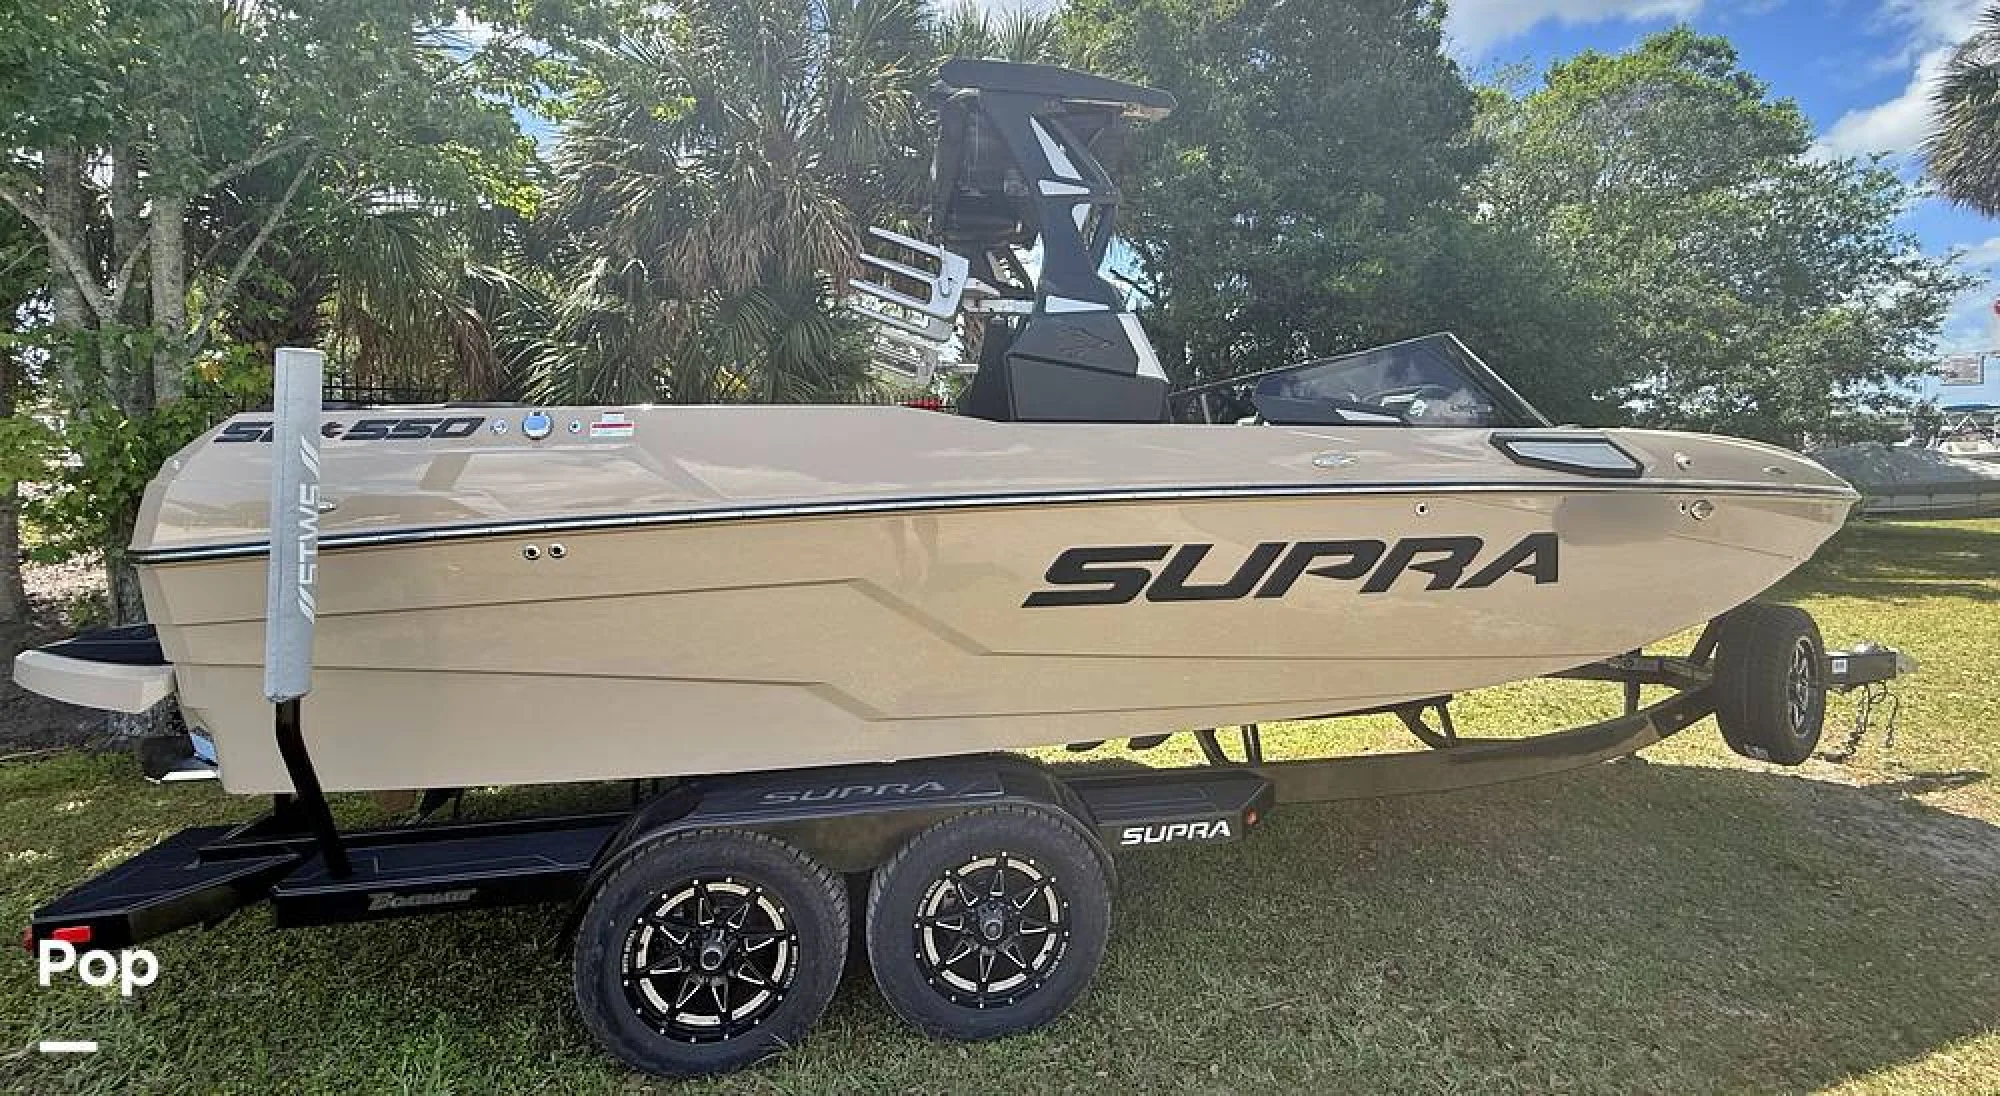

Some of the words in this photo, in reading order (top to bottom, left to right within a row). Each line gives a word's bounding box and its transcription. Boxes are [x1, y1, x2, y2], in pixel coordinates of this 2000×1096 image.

[342, 417, 486, 440] 550
[1021, 531, 1559, 608] SUPRA
[758, 781, 945, 804] SUPRA
[1121, 819, 1231, 845] SUPRA
